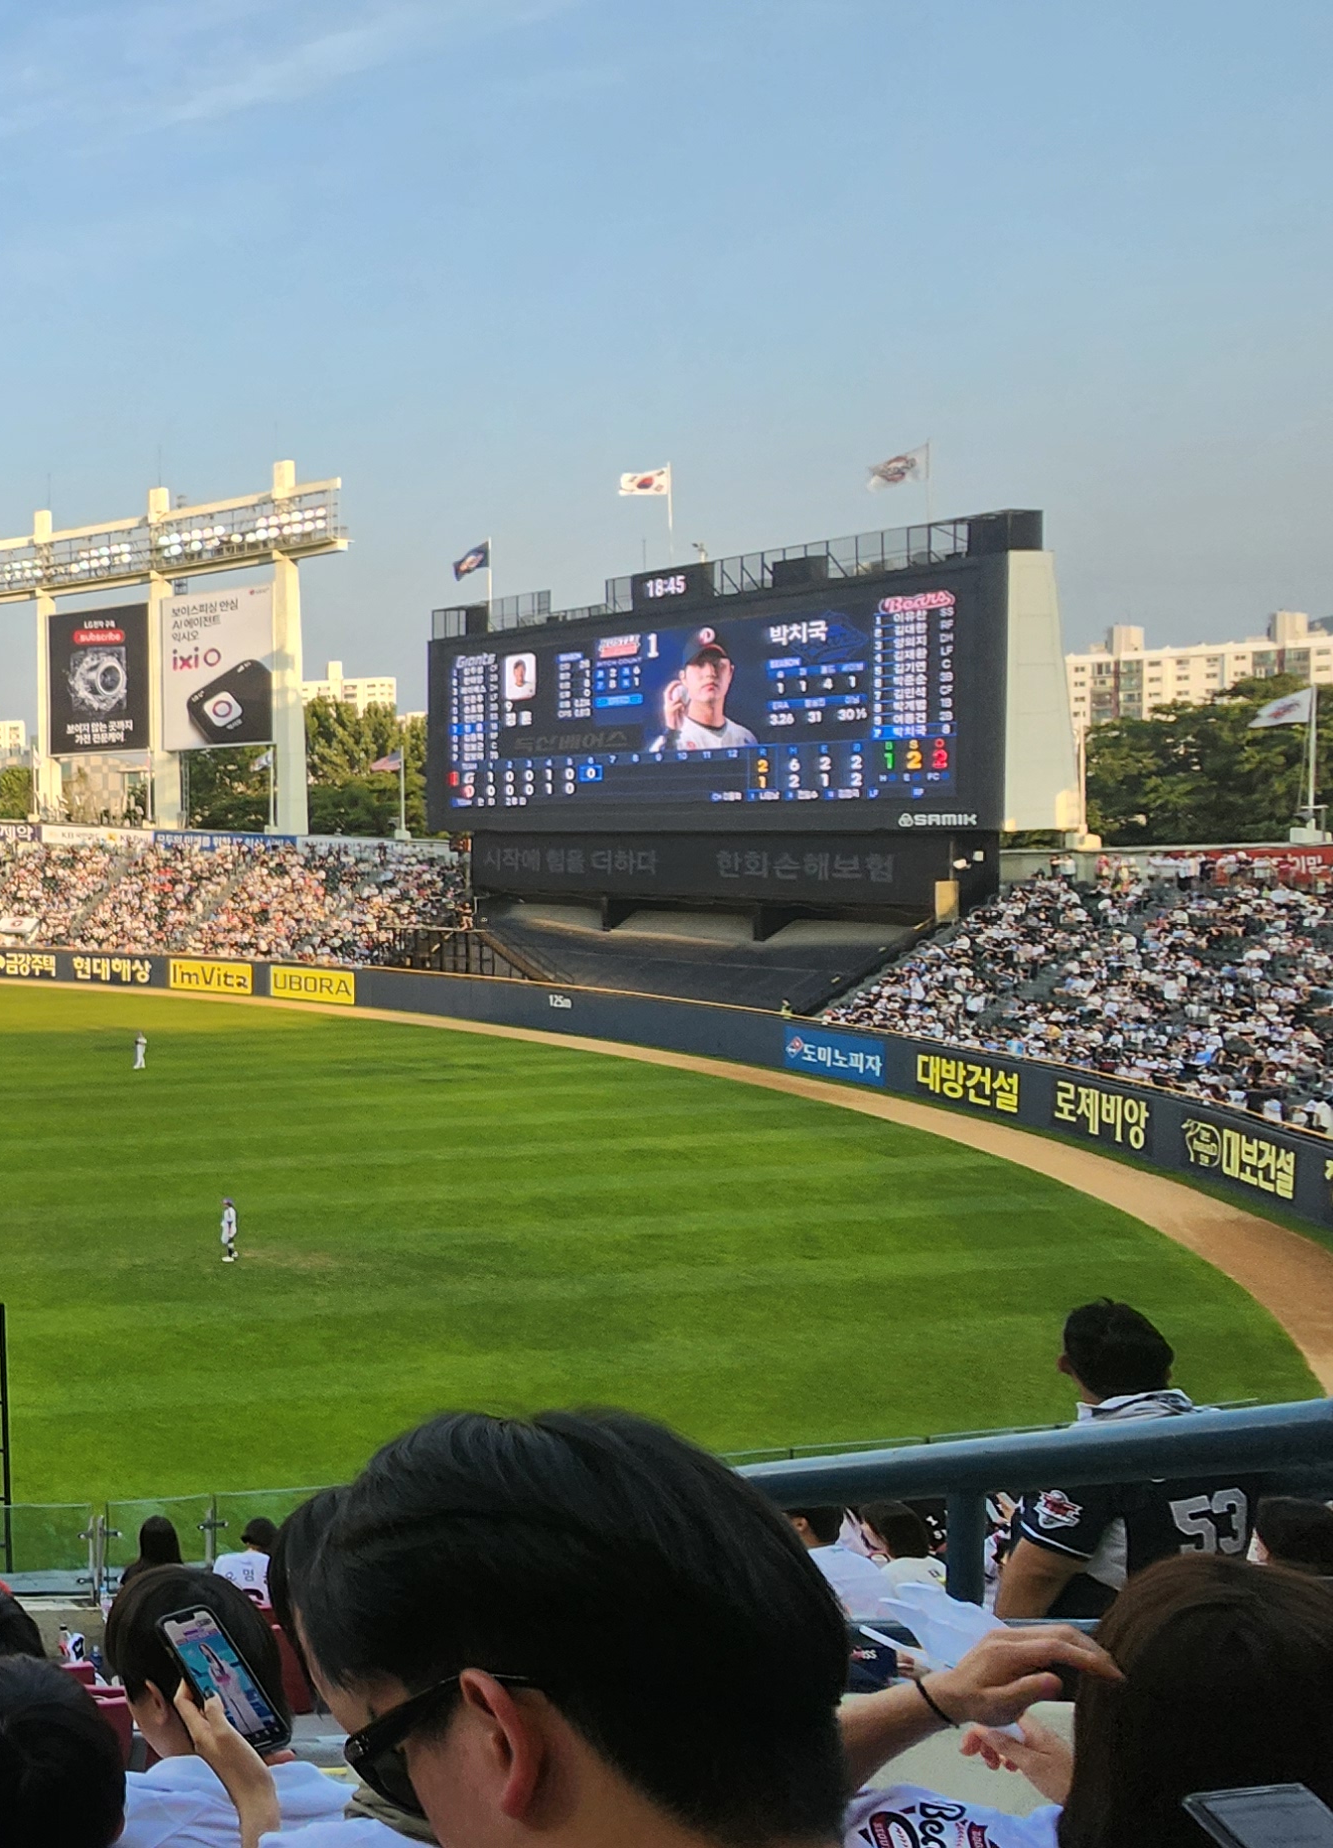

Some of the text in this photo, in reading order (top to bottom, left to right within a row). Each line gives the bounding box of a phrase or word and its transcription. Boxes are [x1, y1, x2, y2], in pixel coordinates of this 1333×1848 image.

[646, 575, 686, 598] 18:45
[171, 597, 239, 617] 보이스피싱 안심
[172, 615, 221, 630] AI 에이전트
[769, 619, 828, 646] 박치국
[79, 631, 121, 642] subscribe
[171, 629, 199, 642] 익시오
[646, 633, 659, 658] 1
[823, 678, 833, 690] 4
[848, 675, 856, 688] 1
[909, 740, 918, 749] S
[935, 738, 944, 748] O
[506, 771, 514, 782] 0
[525, 770, 534, 781] 0
[565, 769, 575, 780] 0
[586, 768, 596, 779] 0
[757, 759, 768, 773] 2
[789, 758, 800, 771] 6
[819, 756, 831, 770] 2
[851, 755, 862, 769] 2
[884, 749, 948, 769] 1 2 2
[487, 785, 496, 796] 0
[506, 784, 514, 796] 0
[525, 784, 534, 795] 0
[565, 783, 575, 794] 0
[758, 776, 767, 789] 1
[789, 775, 800, 788] 2
[821, 773, 829, 787] 1
[851, 772, 862, 787] 2
[927, 772, 940, 781] FC
[913, 813, 977, 827] SAMIK
[714, 850, 896, 884] 한화손해보험
[5, 952, 56, 978] 금강주택
[72, 956, 152, 983] 현대해상
[273, 973, 352, 998] UBORA
[801, 1043, 882, 1077] 도미노피자
[916, 1054, 1019, 1113] 대방건설
[1054, 1080, 1150, 1150] 로제비앙
[1221, 1128, 1296, 1200] 대보건설
[1169, 1487, 1247, 1554] 53
